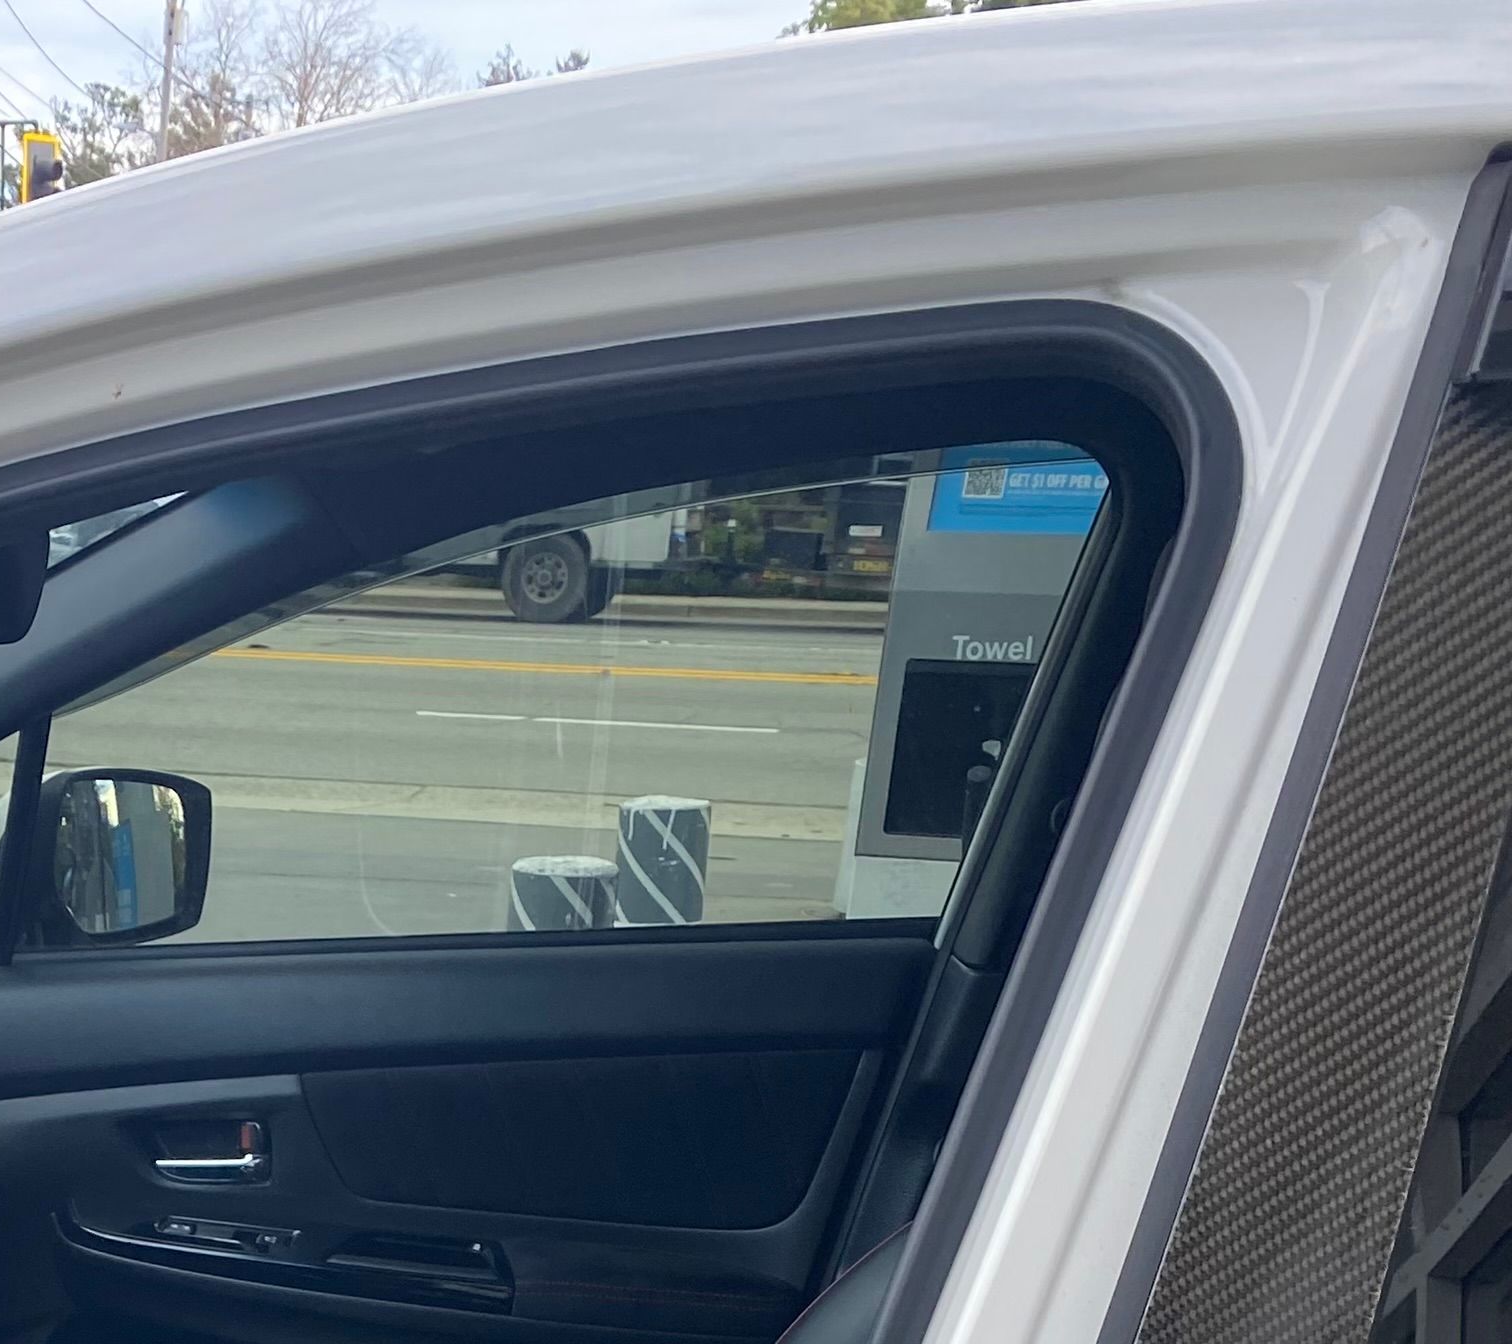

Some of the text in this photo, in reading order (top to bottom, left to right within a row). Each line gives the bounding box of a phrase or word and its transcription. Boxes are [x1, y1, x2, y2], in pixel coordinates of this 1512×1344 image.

[1009, 473, 1031, 488] GET
[1047, 473, 1068, 488] OFF
[952, 634, 1033, 661] Towel
